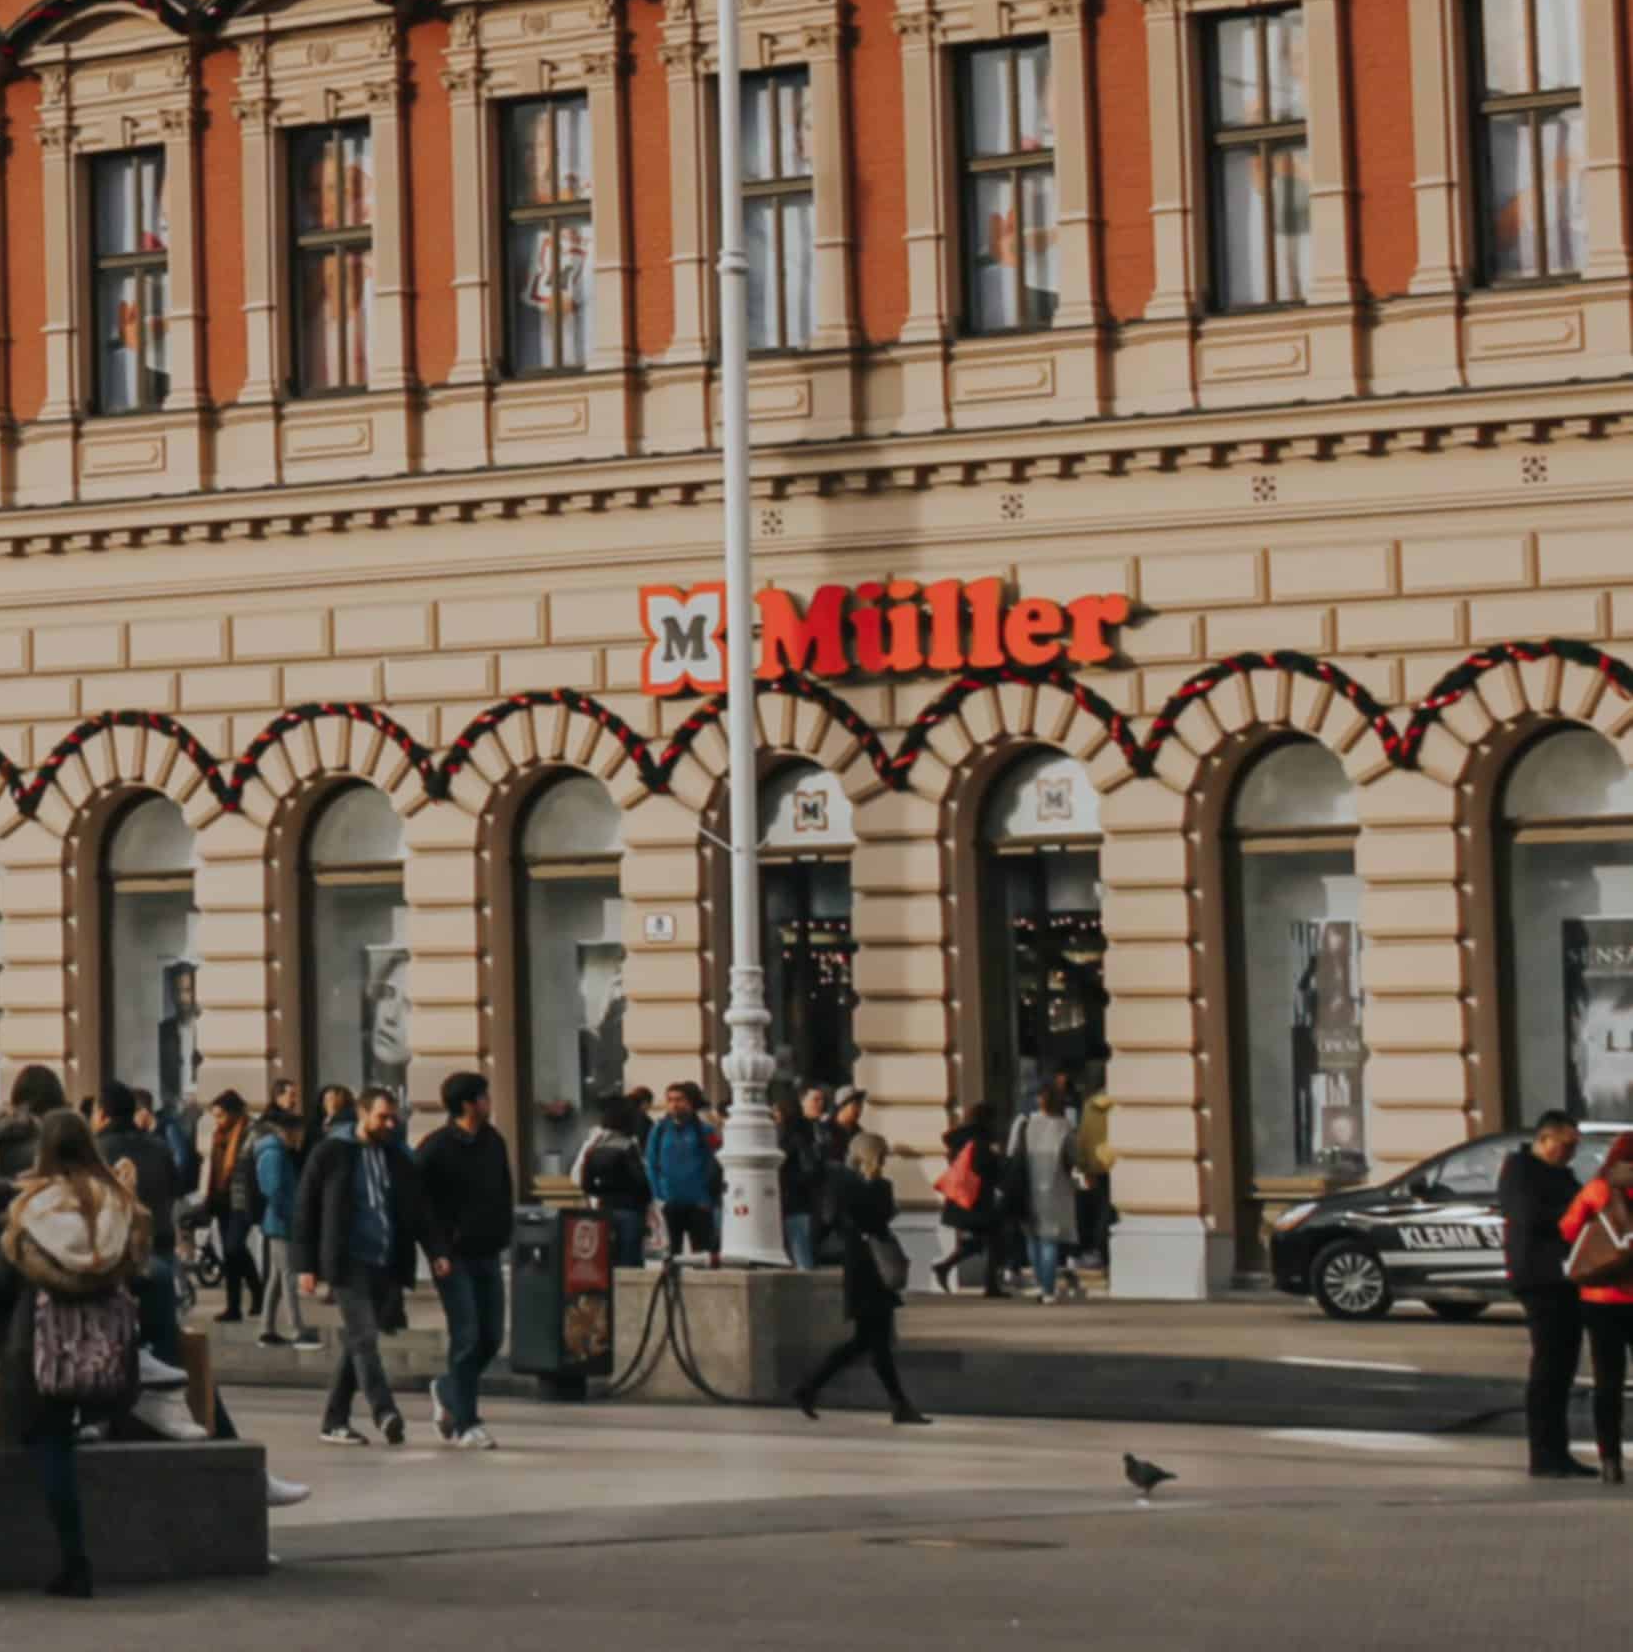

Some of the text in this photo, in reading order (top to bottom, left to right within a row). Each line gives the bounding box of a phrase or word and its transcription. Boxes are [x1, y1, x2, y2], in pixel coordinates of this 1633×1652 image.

[660, 577, 1129, 680] M Müller
[1397, 1225, 1483, 1249] KLEMM
